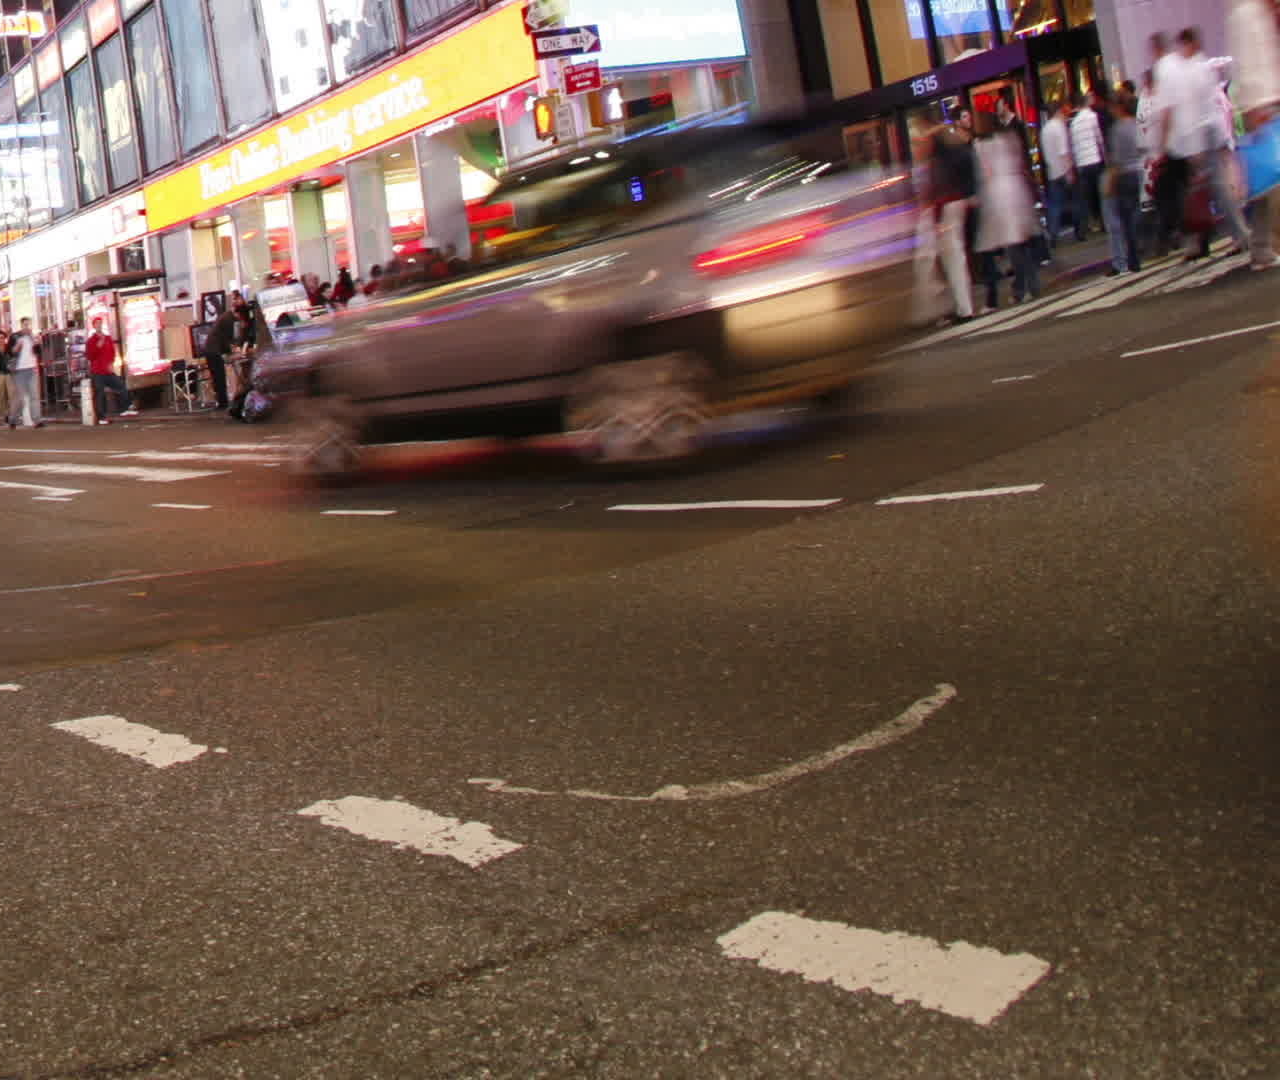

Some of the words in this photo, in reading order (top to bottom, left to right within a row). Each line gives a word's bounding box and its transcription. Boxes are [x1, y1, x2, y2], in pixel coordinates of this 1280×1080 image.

[542, 38, 562, 50] ONE
[571, 33, 591, 47] WAY
[909, 76, 938, 96] 1515
